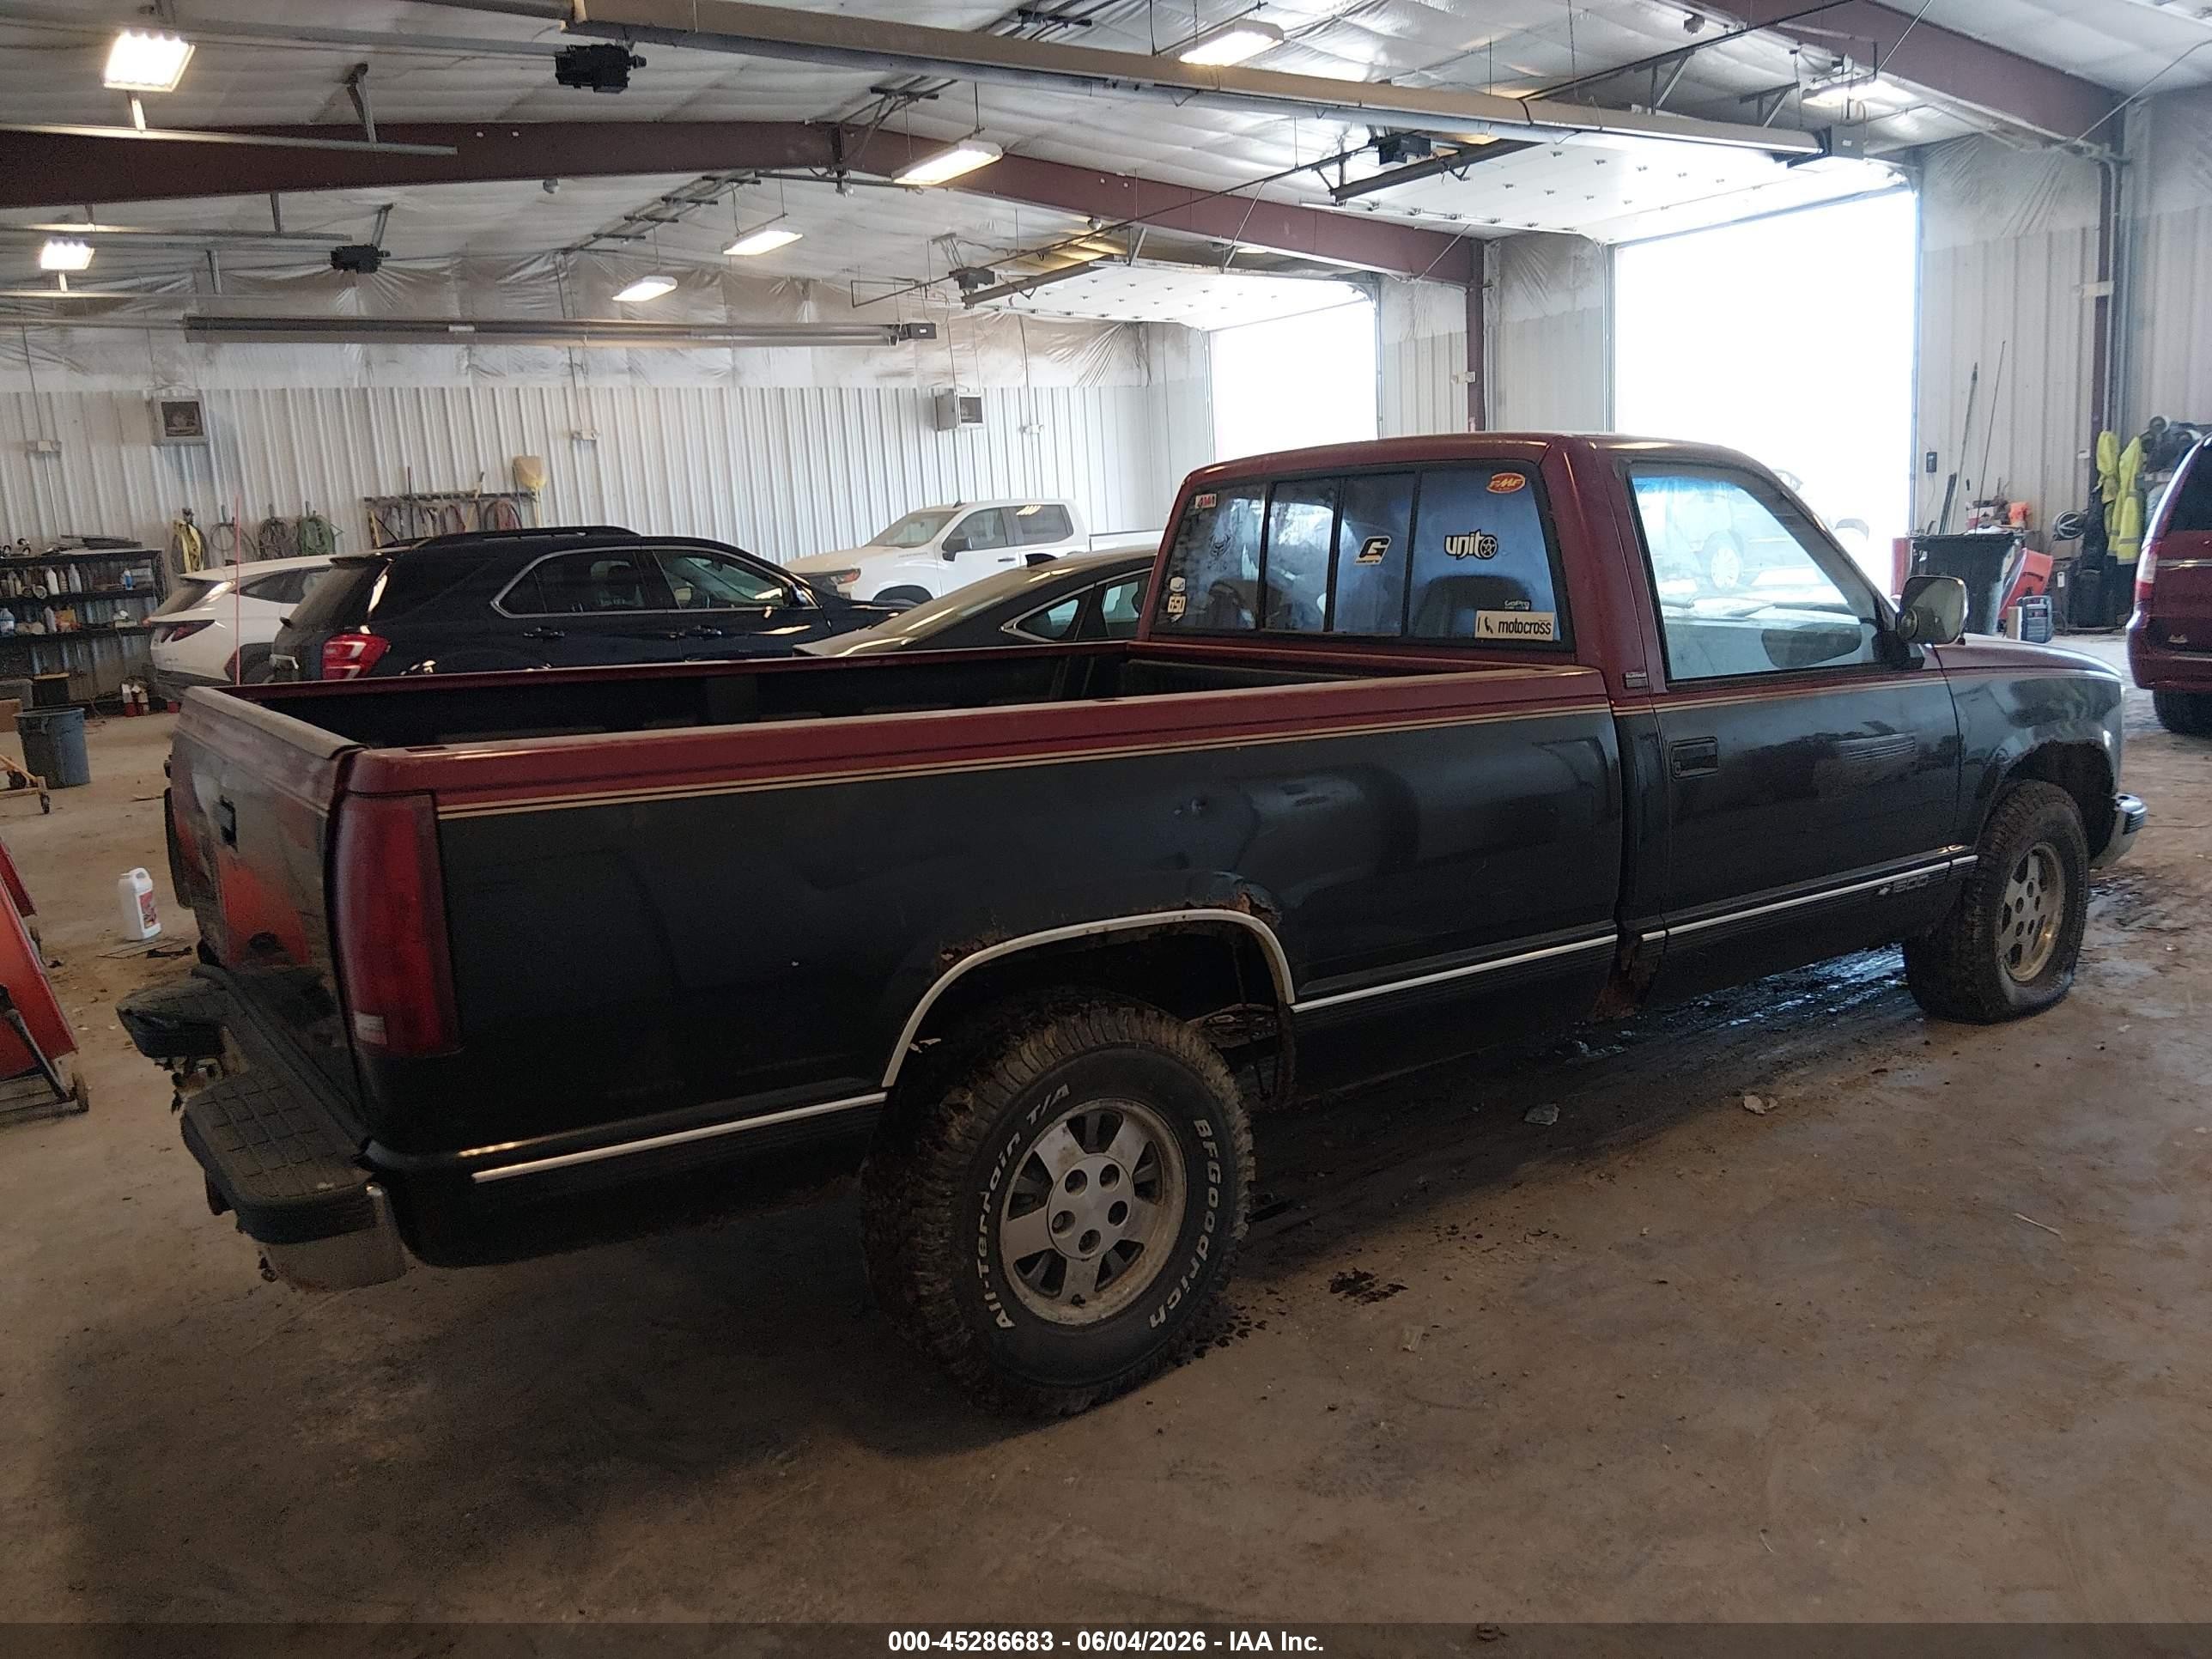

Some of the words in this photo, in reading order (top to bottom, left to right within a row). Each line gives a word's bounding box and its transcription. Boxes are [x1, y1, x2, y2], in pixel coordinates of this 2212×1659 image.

[1498, 617, 1552, 635] motocross
[1026, 1084, 1070, 1125] T/A
[1149, 1119, 1222, 1328] BFGoodrich
